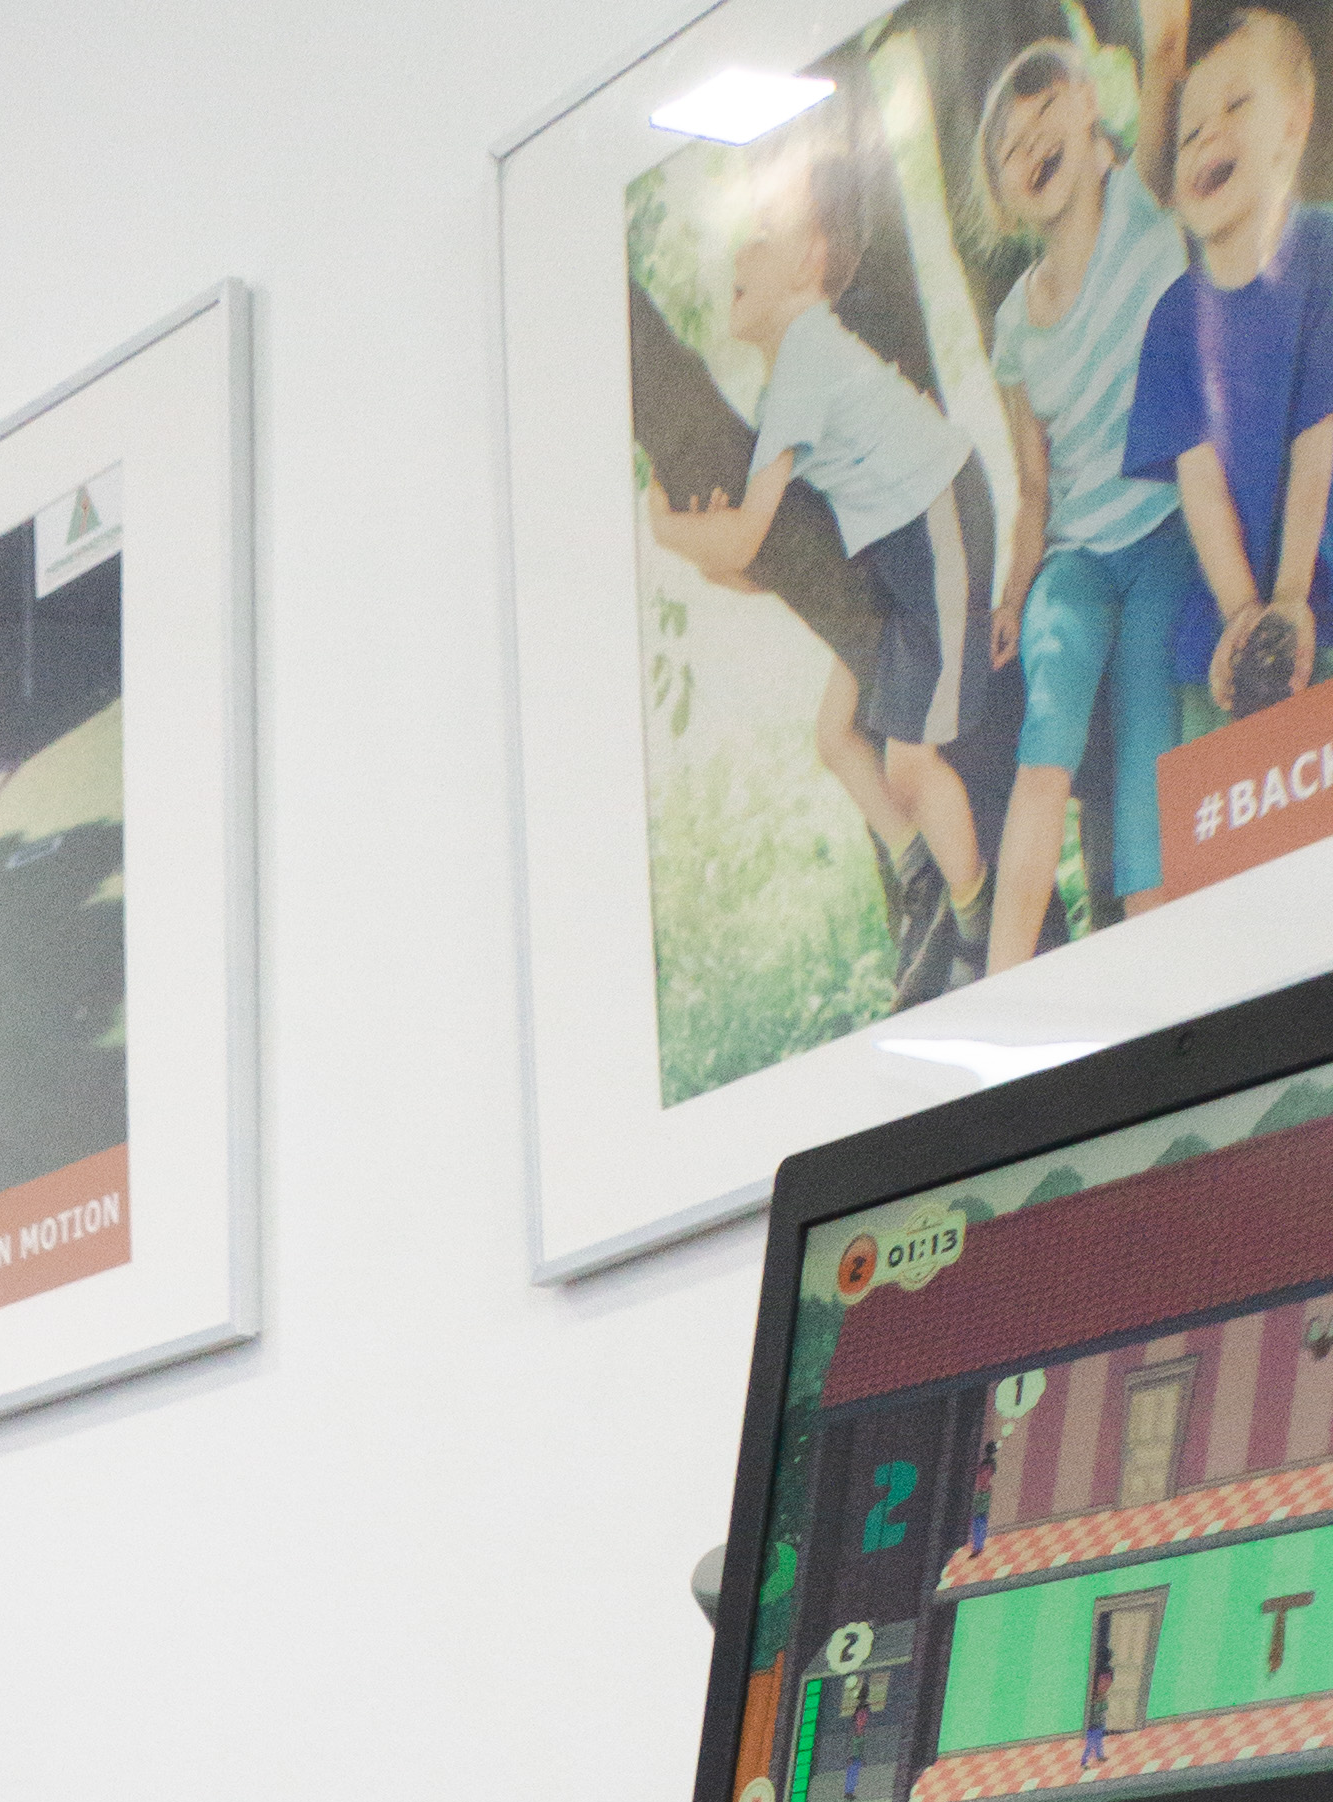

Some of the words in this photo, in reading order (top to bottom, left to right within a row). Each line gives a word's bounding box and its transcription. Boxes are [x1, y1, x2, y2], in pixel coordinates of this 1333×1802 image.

[19, 1191, 121, 1259] MOTION
[887, 1228, 958, 1269] 01:13
[862, 1460, 917, 1553] 2
[839, 1631, 859, 1662] 2
